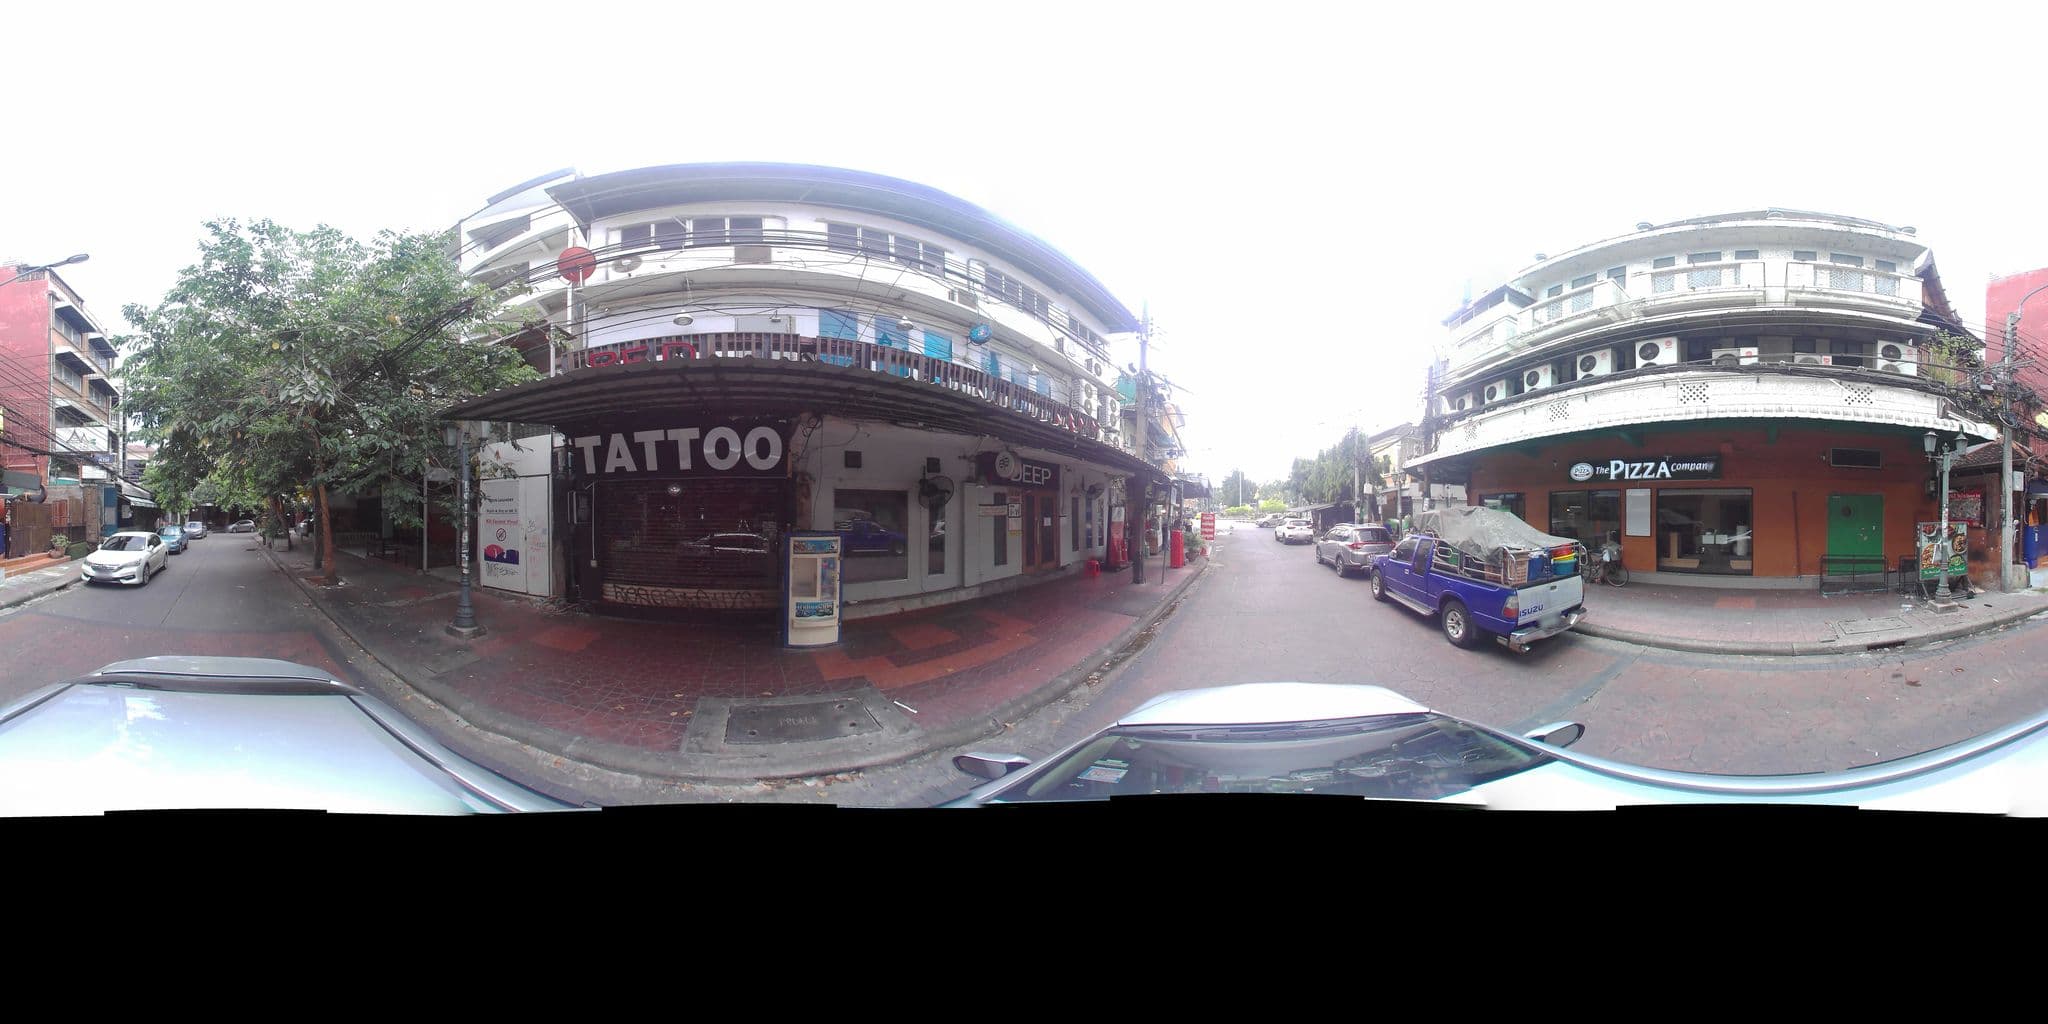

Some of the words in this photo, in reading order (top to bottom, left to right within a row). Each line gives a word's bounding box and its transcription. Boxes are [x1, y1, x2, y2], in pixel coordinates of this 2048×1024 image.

[575, 426, 783, 475] TATTOO
[1595, 466, 1610, 475] The
[1609, 460, 1672, 480] PIZZA
[1519, 604, 1544, 617] ISUZU
